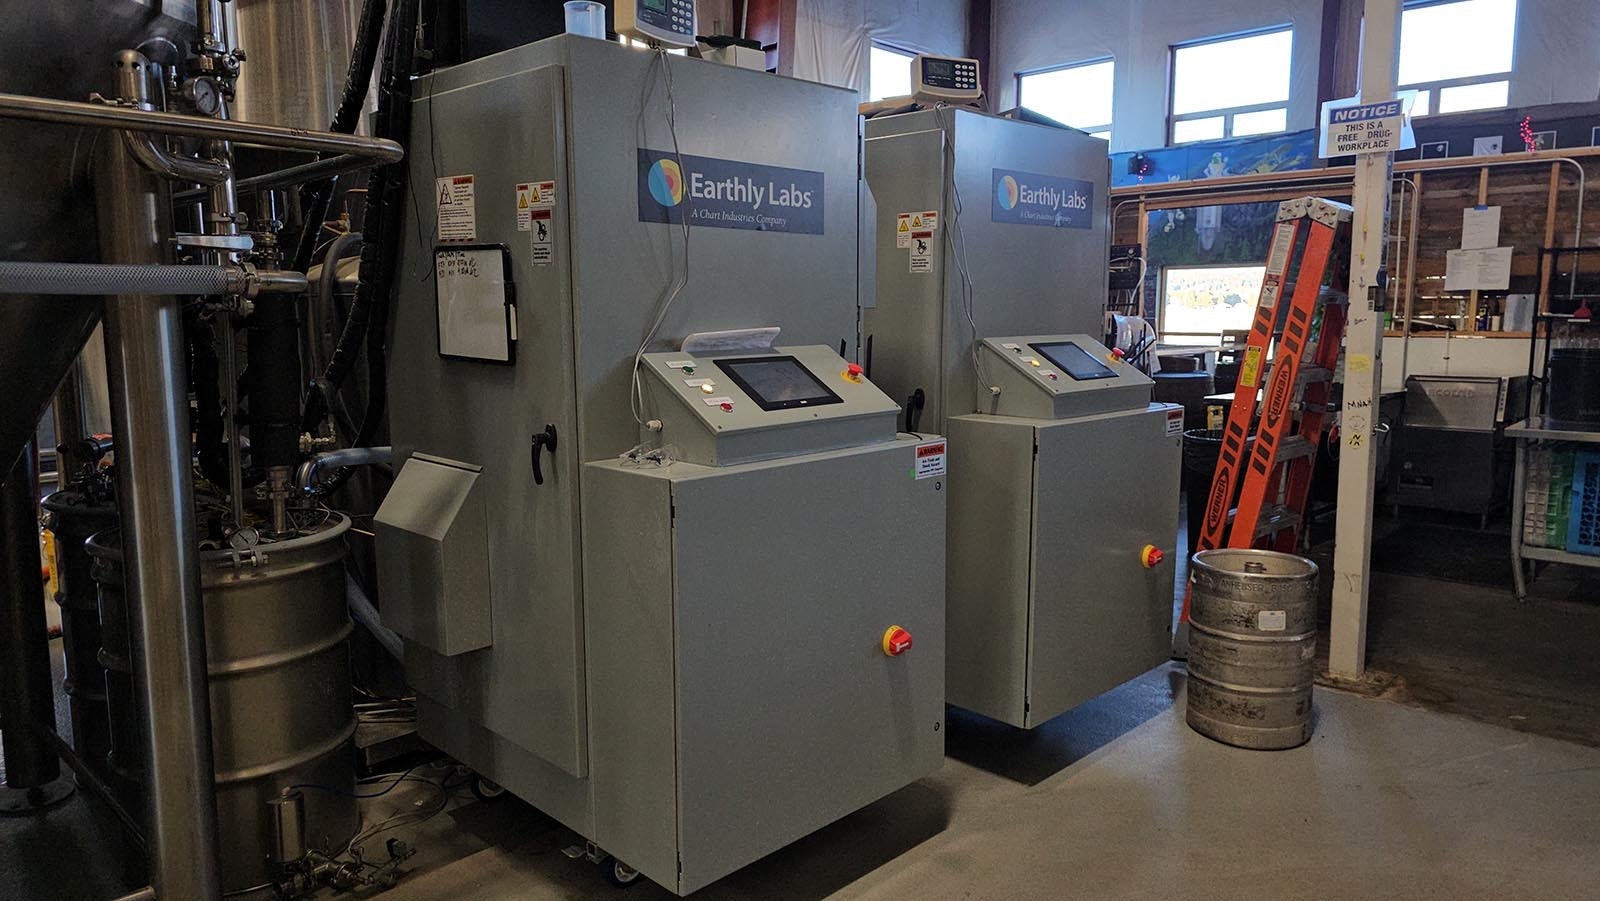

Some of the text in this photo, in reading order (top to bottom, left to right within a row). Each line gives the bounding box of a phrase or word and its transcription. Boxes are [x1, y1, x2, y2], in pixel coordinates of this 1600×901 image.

[1335, 104, 1396, 121] NOTICE
[1346, 121, 1383, 132] THIS IS A
[1338, 133, 1358, 142] FREE
[1338, 140, 1389, 152] WORKPLACE
[691, 172, 812, 210] Earthly Labs
[1020, 184, 1086, 211] Earthly Labs
[691, 208, 786, 228] A Chart Industries Company
[1270, 369, 1289, 418] WERNER
[1211, 479, 1227, 523] WERNER
